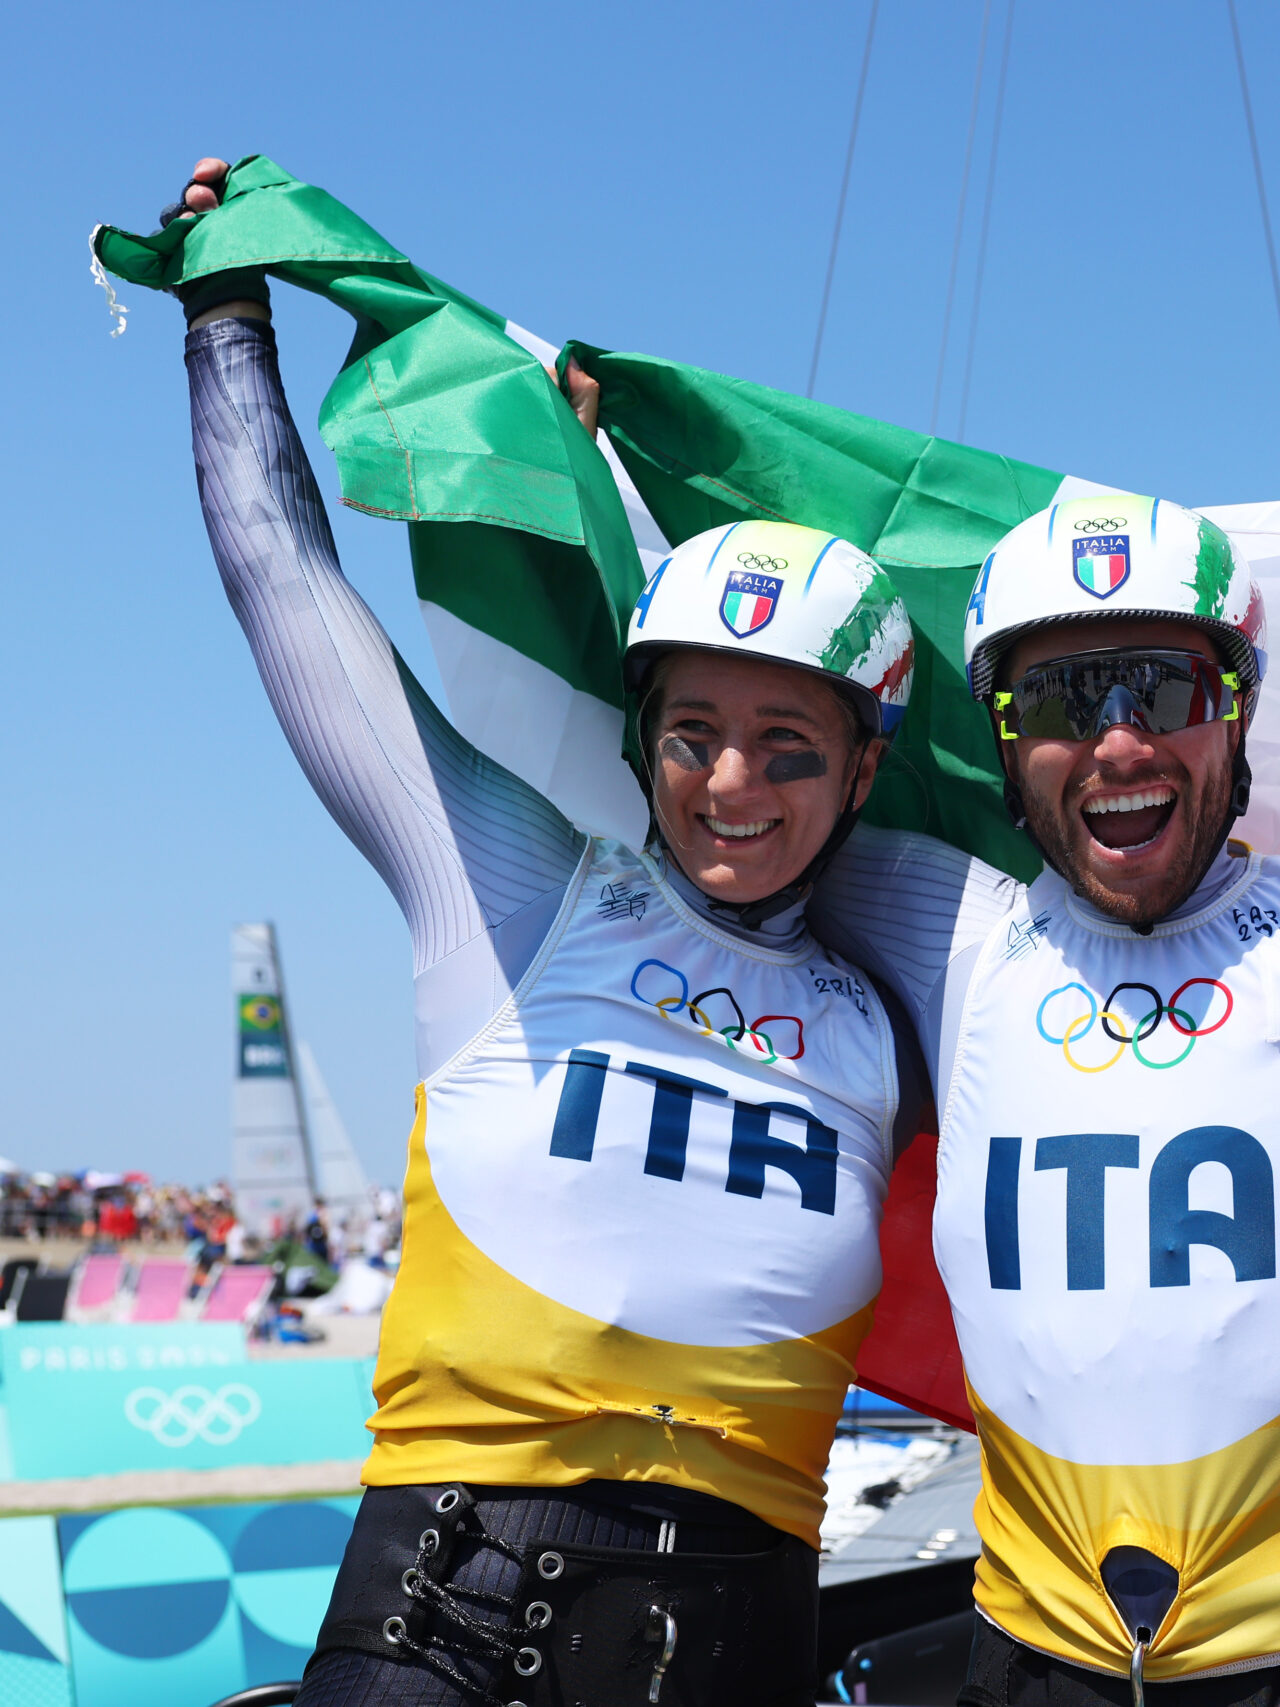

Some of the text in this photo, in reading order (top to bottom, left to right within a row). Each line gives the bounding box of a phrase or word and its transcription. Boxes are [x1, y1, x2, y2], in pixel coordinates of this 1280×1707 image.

[1076, 538, 1125, 550] ITALIA
[730, 573, 777, 590] ITALIA
[738, 583, 768, 594] TEAM
[549, 1048, 839, 1216] ITA
[984, 1125, 1276, 1290] ITA
[20, 1345, 128, 1372] PARIS
